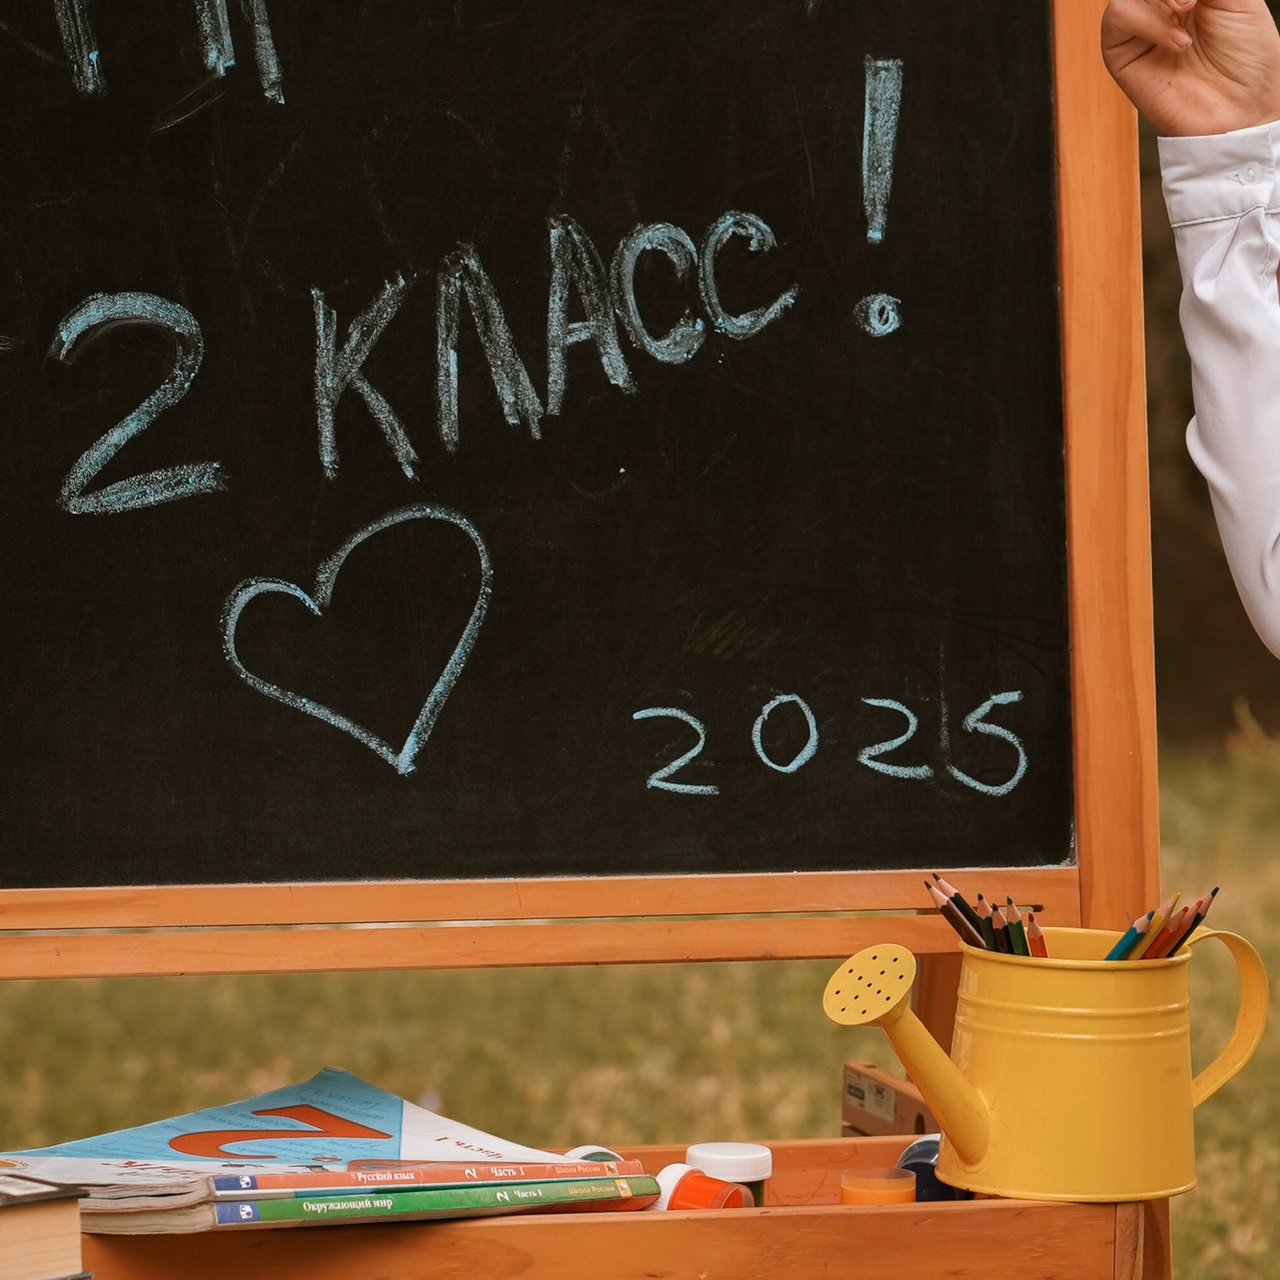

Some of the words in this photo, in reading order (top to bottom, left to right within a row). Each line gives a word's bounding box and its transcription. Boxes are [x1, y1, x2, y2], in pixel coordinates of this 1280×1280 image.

[45, 290, 230, 515] 2
[631, 690, 1028, 797] 2025
[490, 1167, 517, 1177] Часть
[555, 1164, 578, 1174] Школа
[578, 1164, 601, 1174] России
[357, 1171, 393, 1183] Русский
[393, 1171, 416, 1181] язык
[513, 1190, 537, 1199] Часть
[568, 1185, 592, 1195] Школа
[592, 1184, 616, 1194] России
[303, 1199, 372, 1213] Окружающий
[373, 1198, 393, 1210] мир
